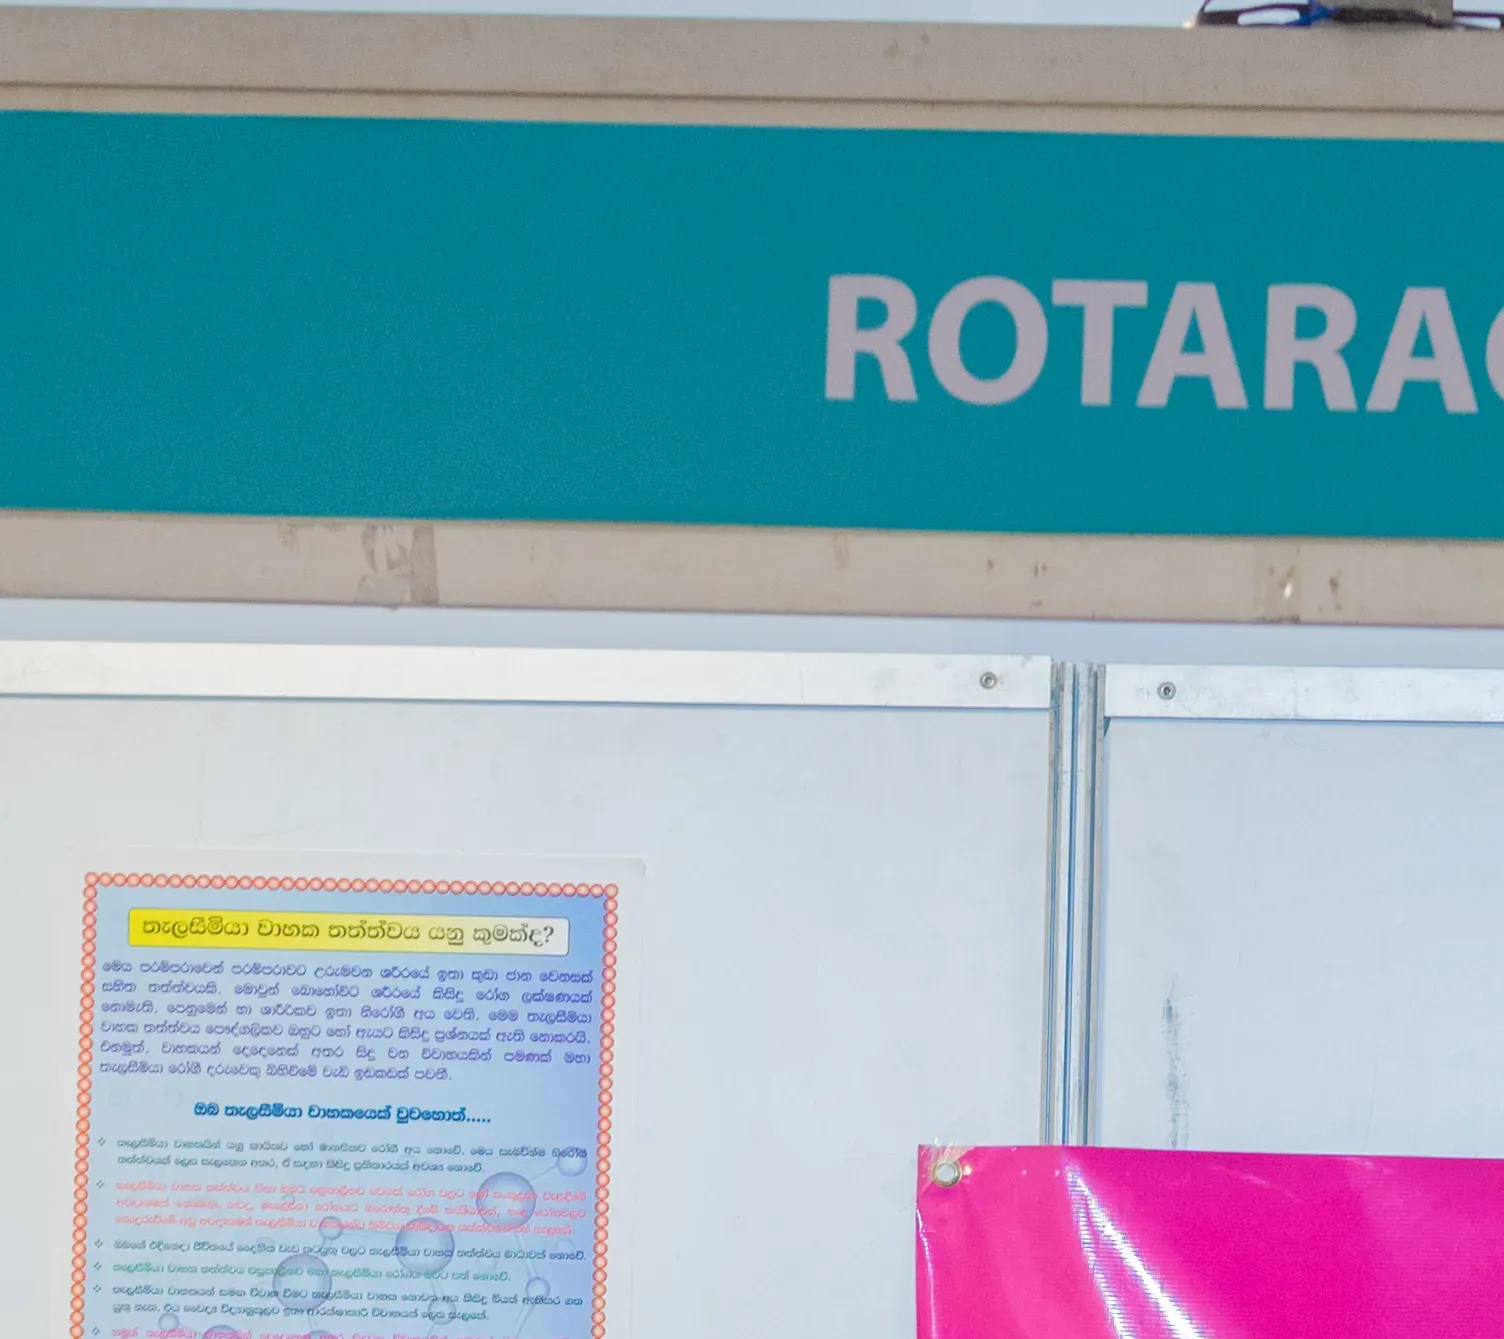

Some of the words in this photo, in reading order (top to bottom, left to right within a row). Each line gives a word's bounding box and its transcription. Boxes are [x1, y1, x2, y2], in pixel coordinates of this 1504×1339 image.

[142, 914, 250, 940] තැලසීමියා
[256, 918, 321, 939] වාහක
[328, 918, 421, 941] තත්ත්වය
[428, 925, 465, 947] යනු
[472, 922, 555, 948] කුමක්ද?
